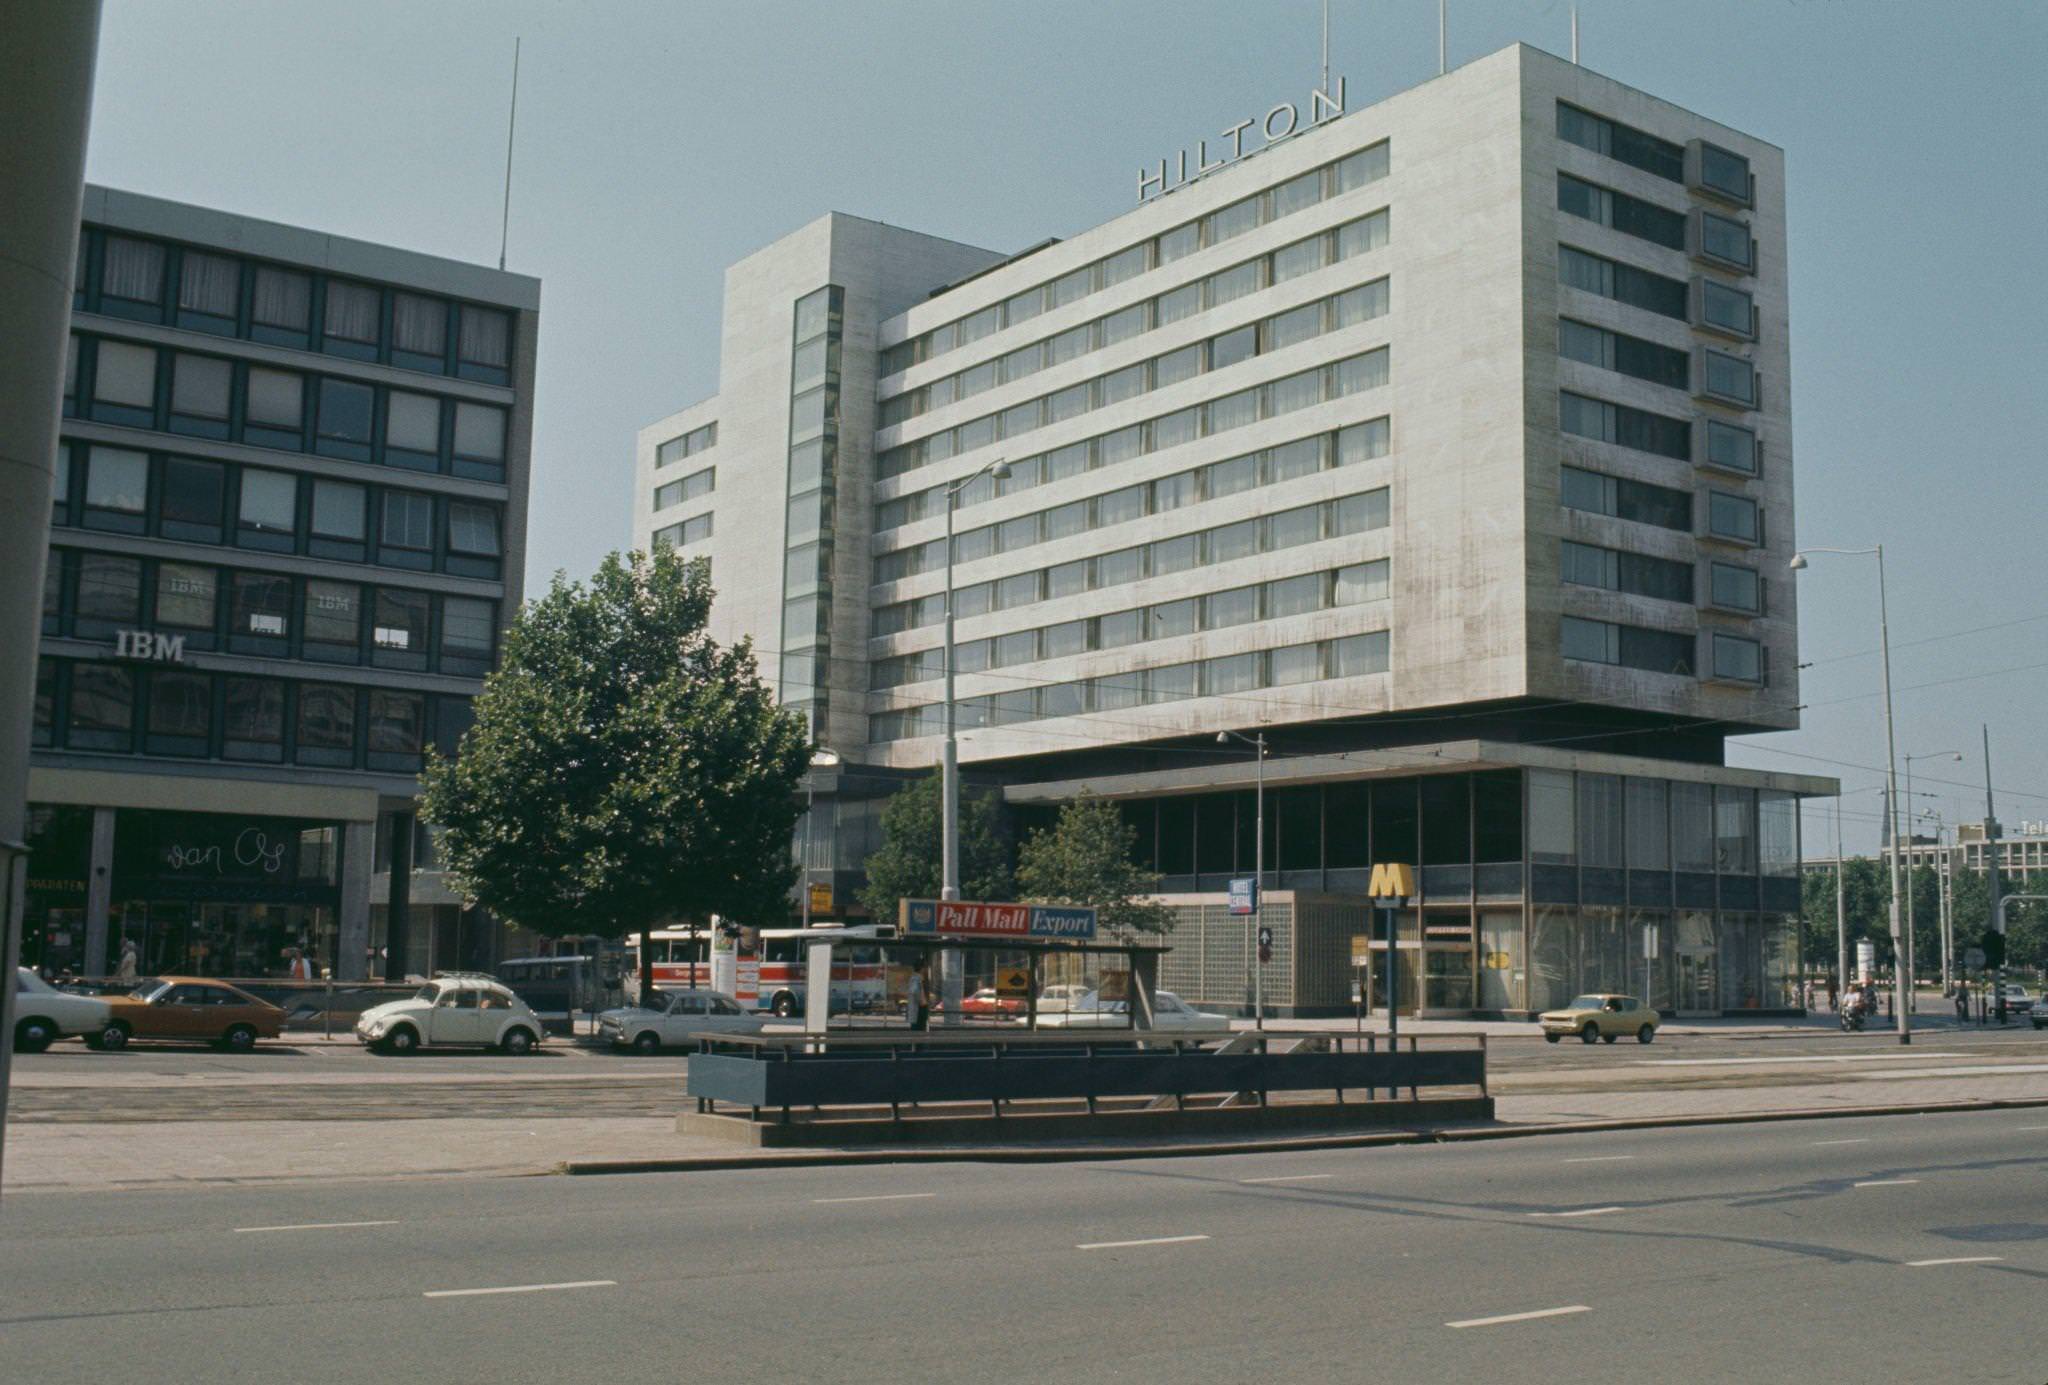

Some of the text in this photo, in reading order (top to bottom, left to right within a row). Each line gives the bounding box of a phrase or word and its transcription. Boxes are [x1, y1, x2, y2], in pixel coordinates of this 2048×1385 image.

[1138, 75, 1346, 202] HILTON
[170, 578, 206, 595] IBM
[316, 595, 350, 611] IBM
[114, 629, 187, 662] IBM
[2021, 819, 2048, 835] Tel
[166, 844, 223, 873] van
[1367, 863, 1413, 897] M
[938, 906, 1090, 934] Pall Mall Export
